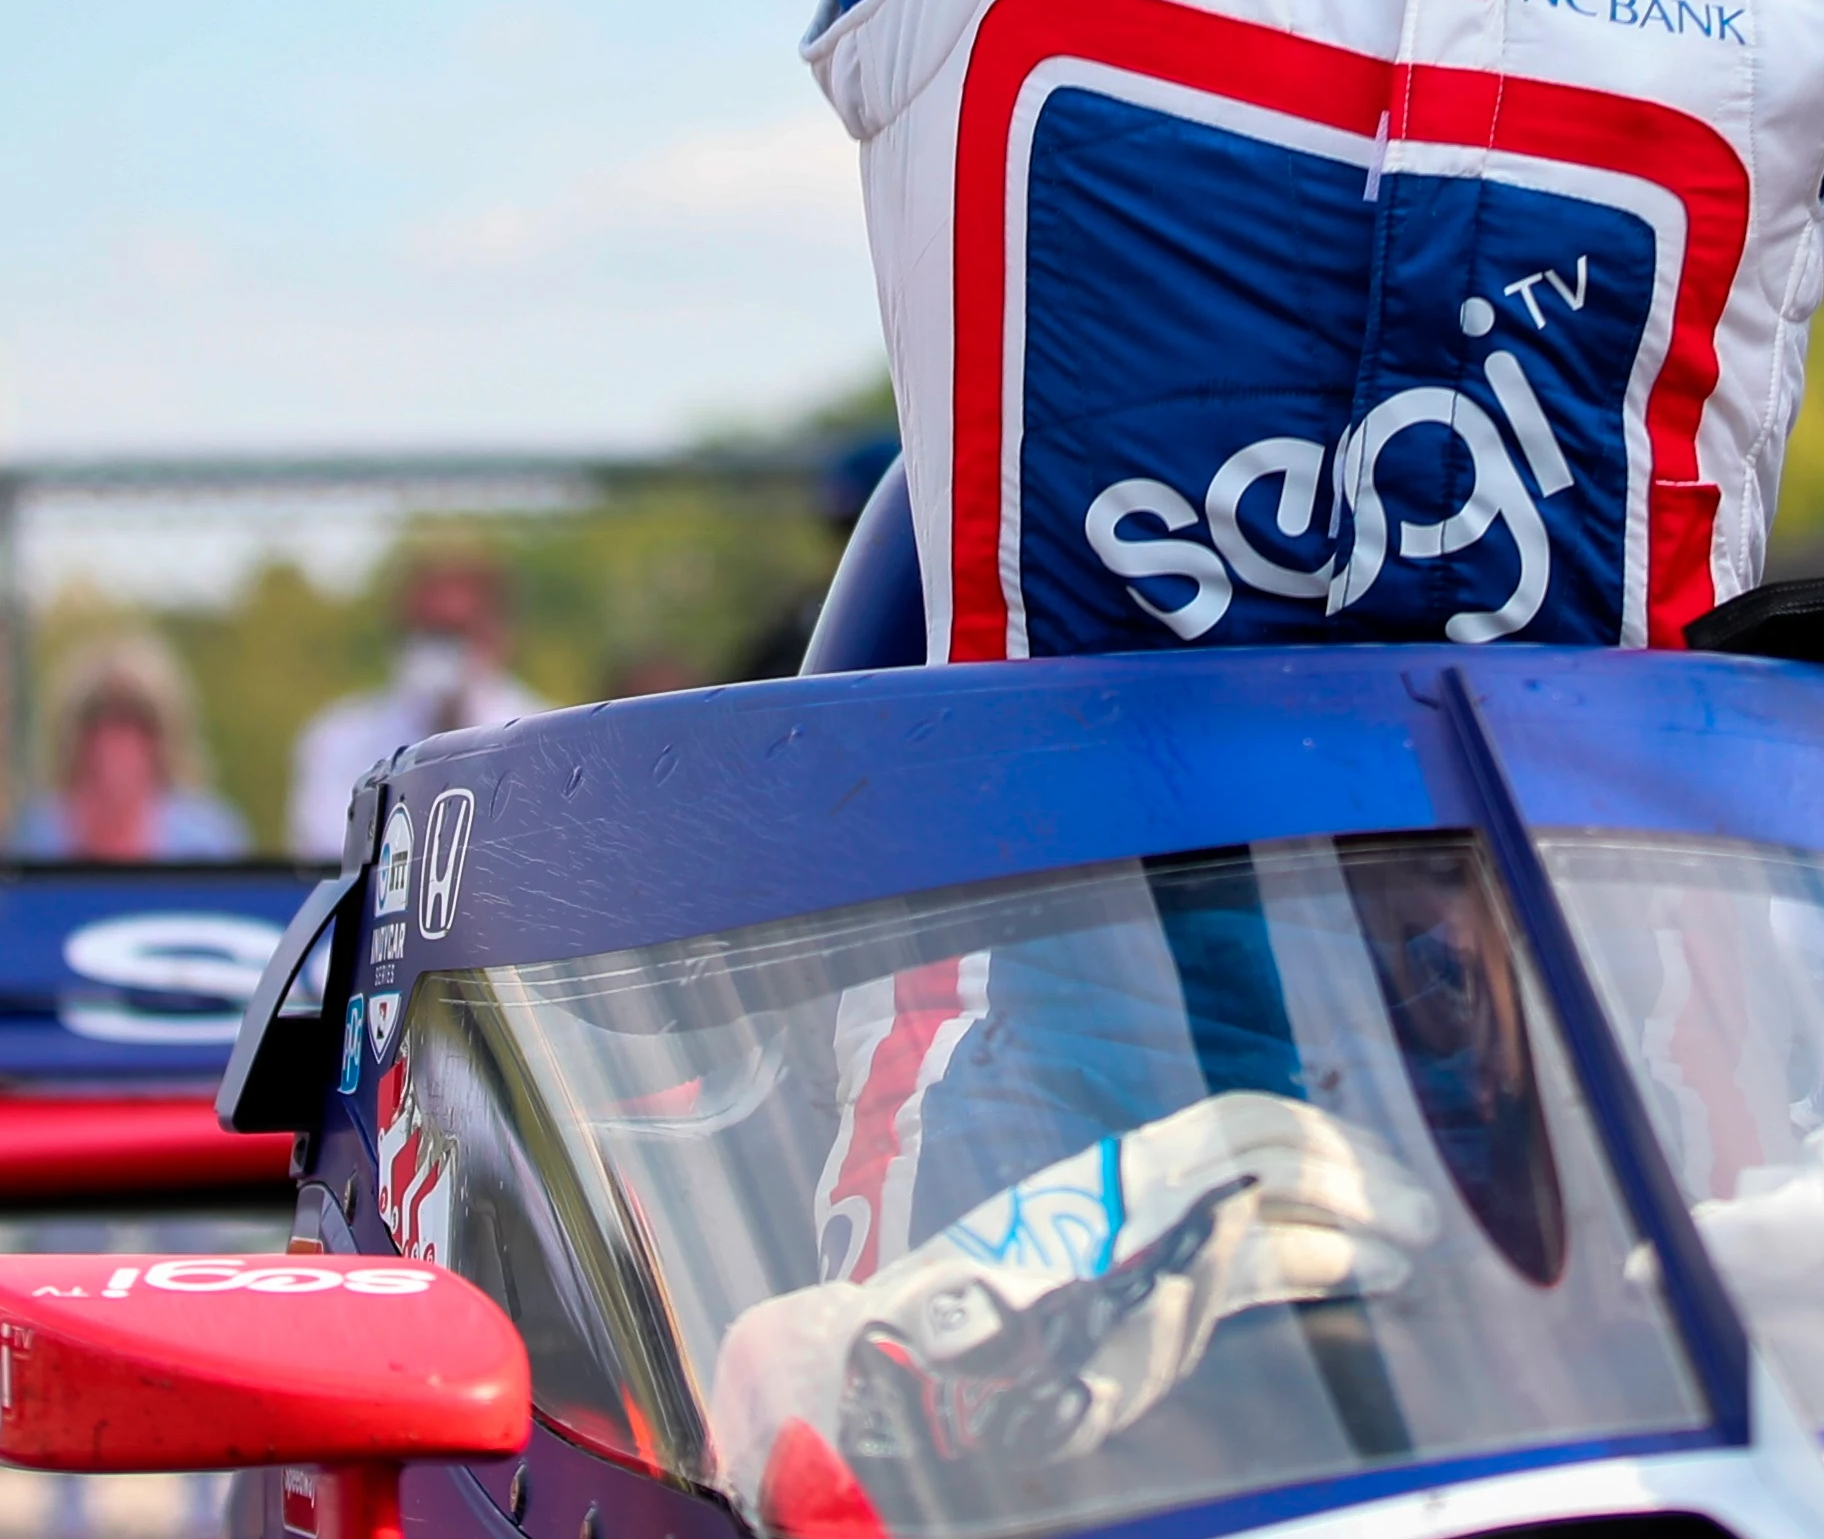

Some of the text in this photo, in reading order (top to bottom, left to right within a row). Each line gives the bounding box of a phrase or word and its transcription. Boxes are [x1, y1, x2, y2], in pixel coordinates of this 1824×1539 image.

[1084, 255, 1588, 645] segi TV
[11, 1325, 34, 1351] TV
